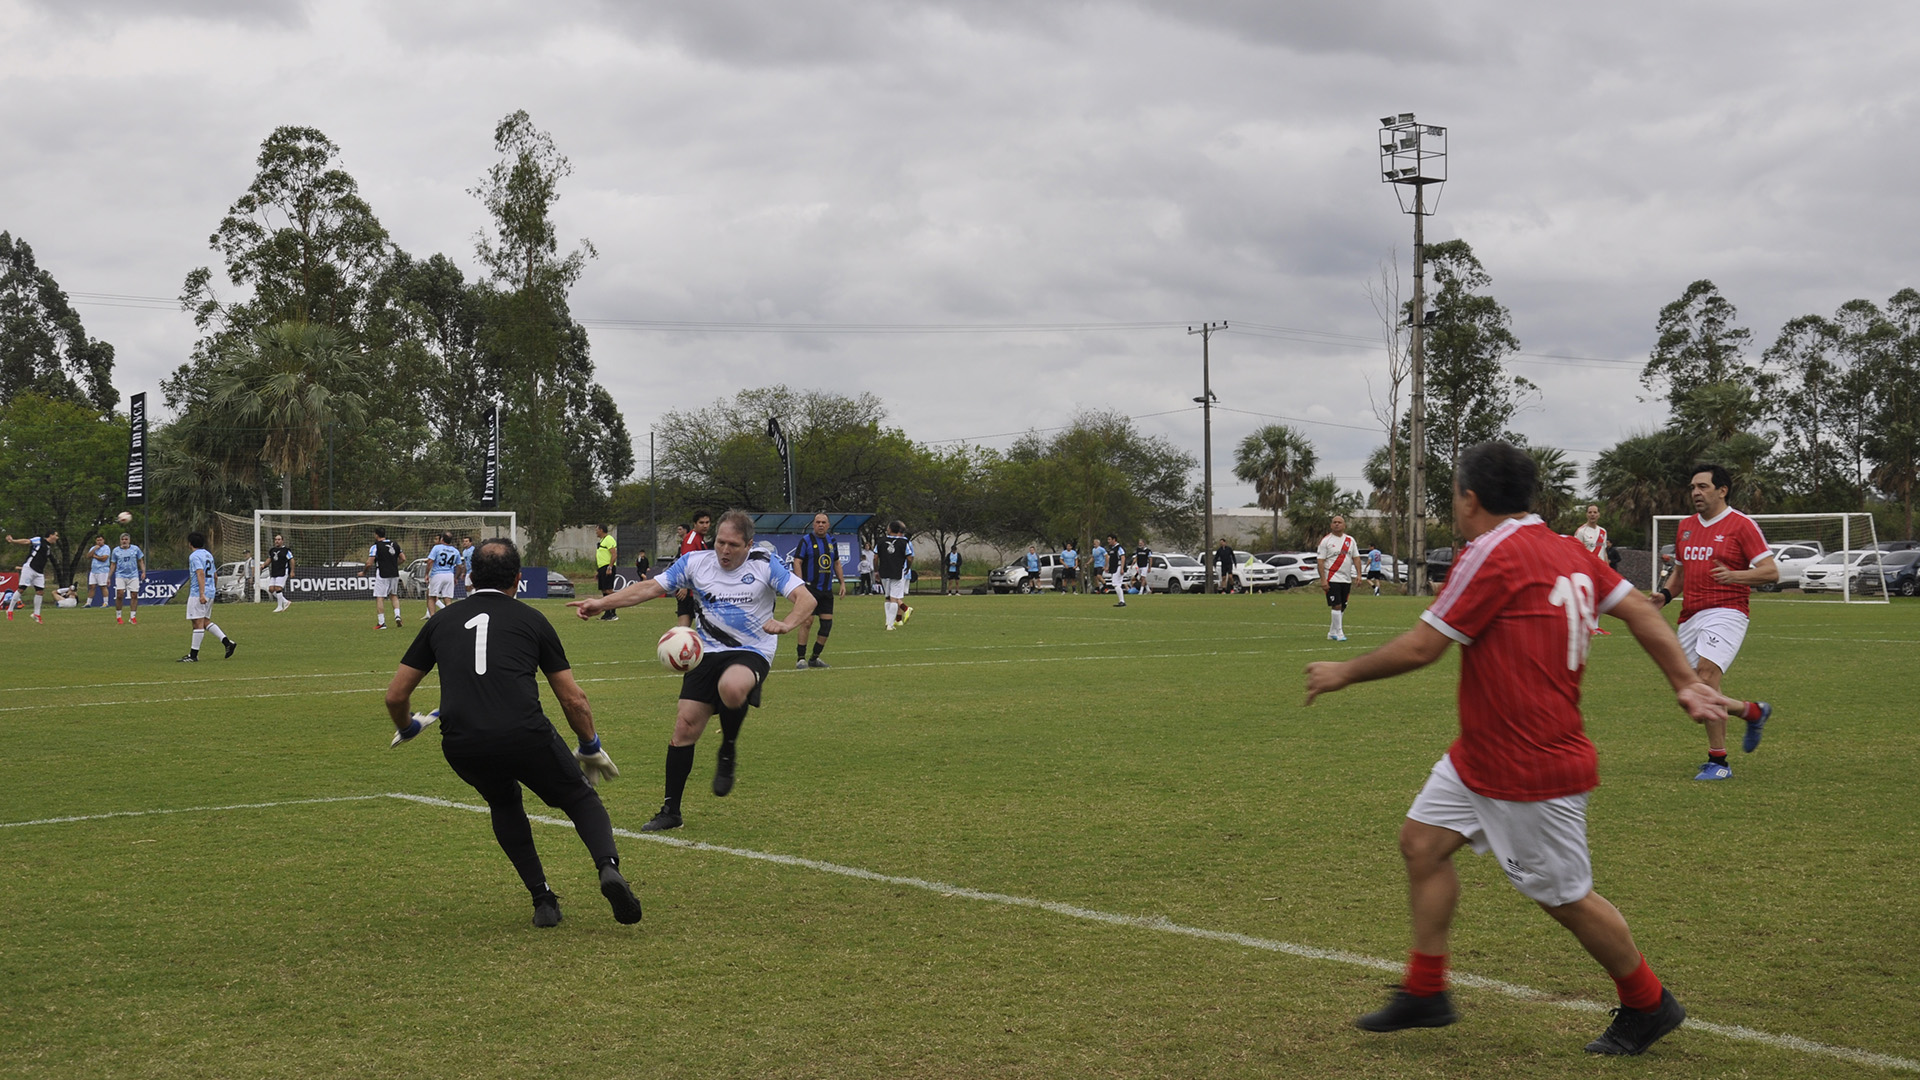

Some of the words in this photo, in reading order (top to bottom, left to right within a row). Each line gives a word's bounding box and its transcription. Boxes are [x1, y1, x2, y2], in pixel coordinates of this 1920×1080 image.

[439, 553, 455, 567] 34
[1684, 546, 1713, 560] CCCP
[464, 613, 490, 675] 1
